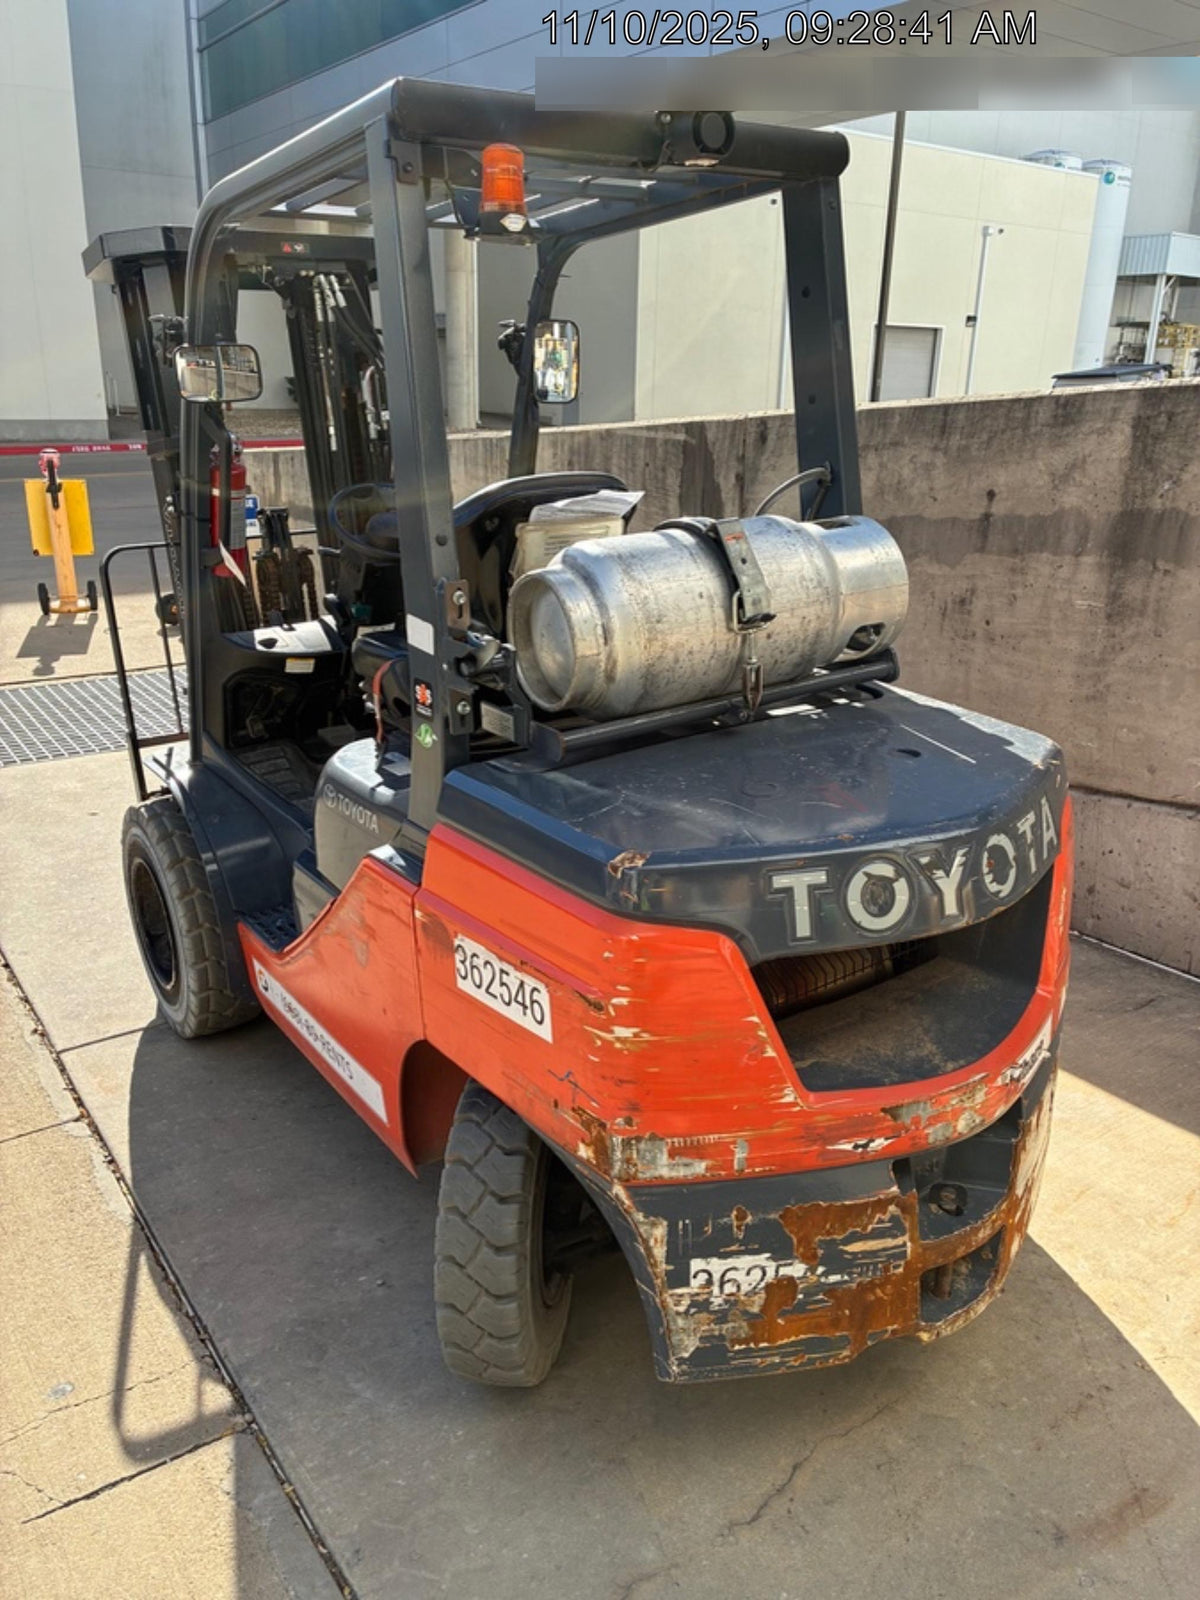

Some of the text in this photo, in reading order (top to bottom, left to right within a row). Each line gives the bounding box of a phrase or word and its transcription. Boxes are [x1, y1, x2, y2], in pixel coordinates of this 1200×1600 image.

[337, 793, 379, 834] TOYOTA
[771, 796, 1058, 938] TOYOTA
[454, 943, 545, 1026] 362546
